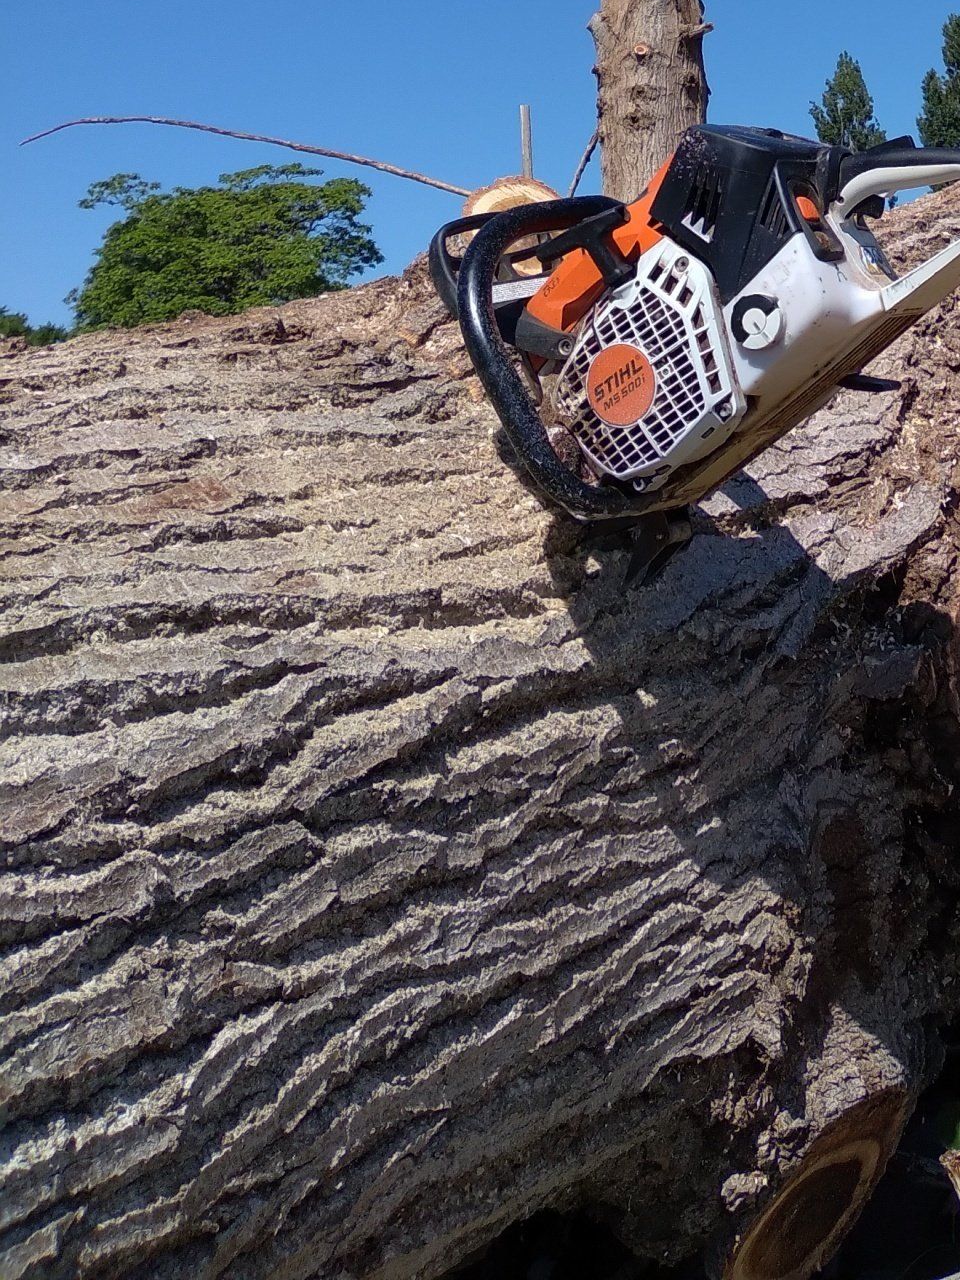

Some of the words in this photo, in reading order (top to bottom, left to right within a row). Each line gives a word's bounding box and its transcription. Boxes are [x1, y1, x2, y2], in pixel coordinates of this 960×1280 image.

[594, 359, 643, 403] STIHL
[603, 393, 621, 411] MS
[621, 373, 645, 398] 500i
